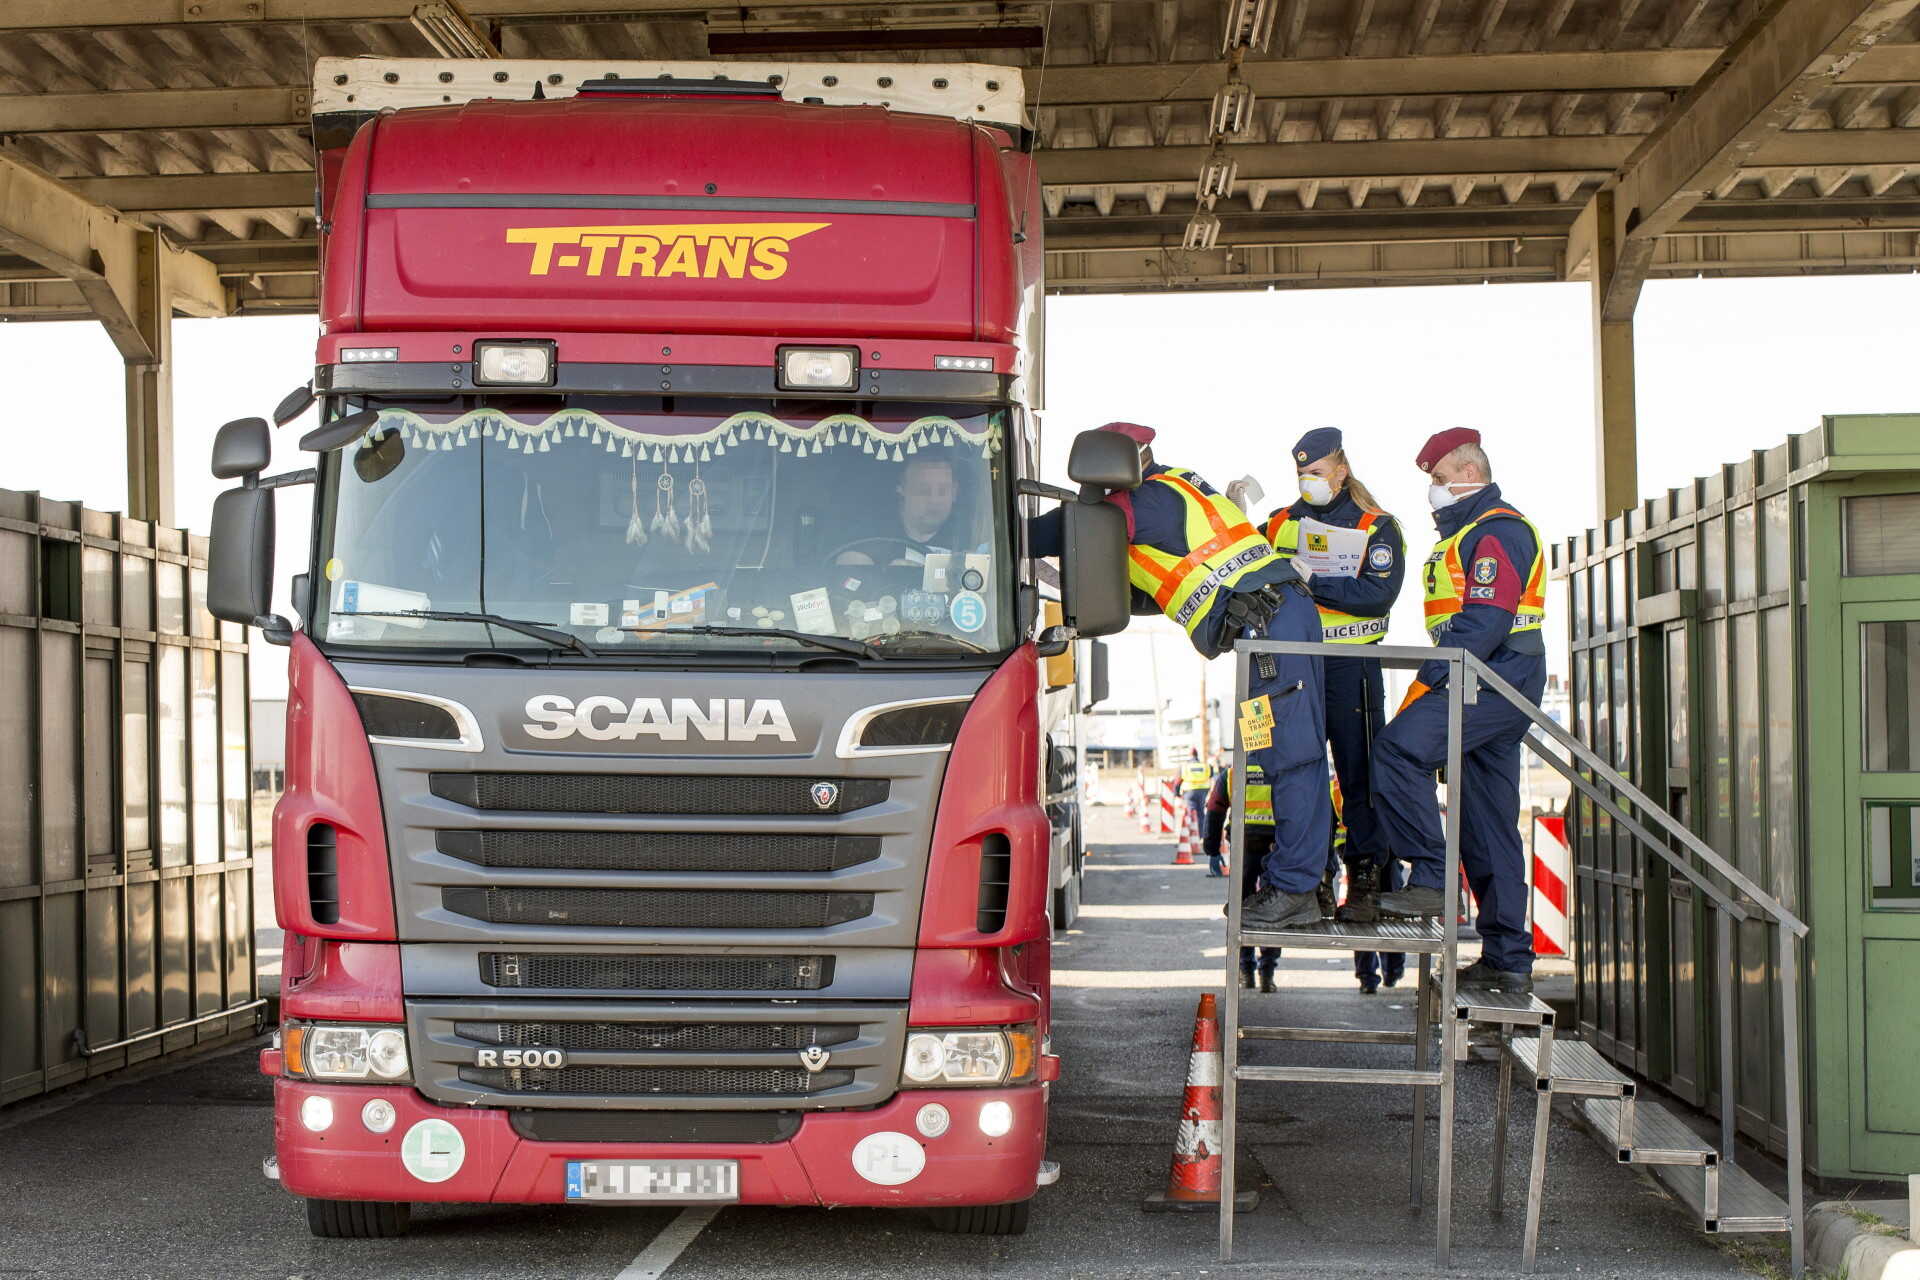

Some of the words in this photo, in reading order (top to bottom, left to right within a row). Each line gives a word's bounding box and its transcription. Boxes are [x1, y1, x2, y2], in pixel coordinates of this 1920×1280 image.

[507, 223, 832, 281] T-TRANS
[1194, 561, 1237, 603] POLICE
[523, 694, 797, 742] SCANIA
[1245, 739, 1270, 748] TRANSIT
[478, 1049, 498, 1067] R
[502, 1049, 563, 1067] 500
[422, 1128, 449, 1169] L
[864, 1144, 913, 1173] PL
